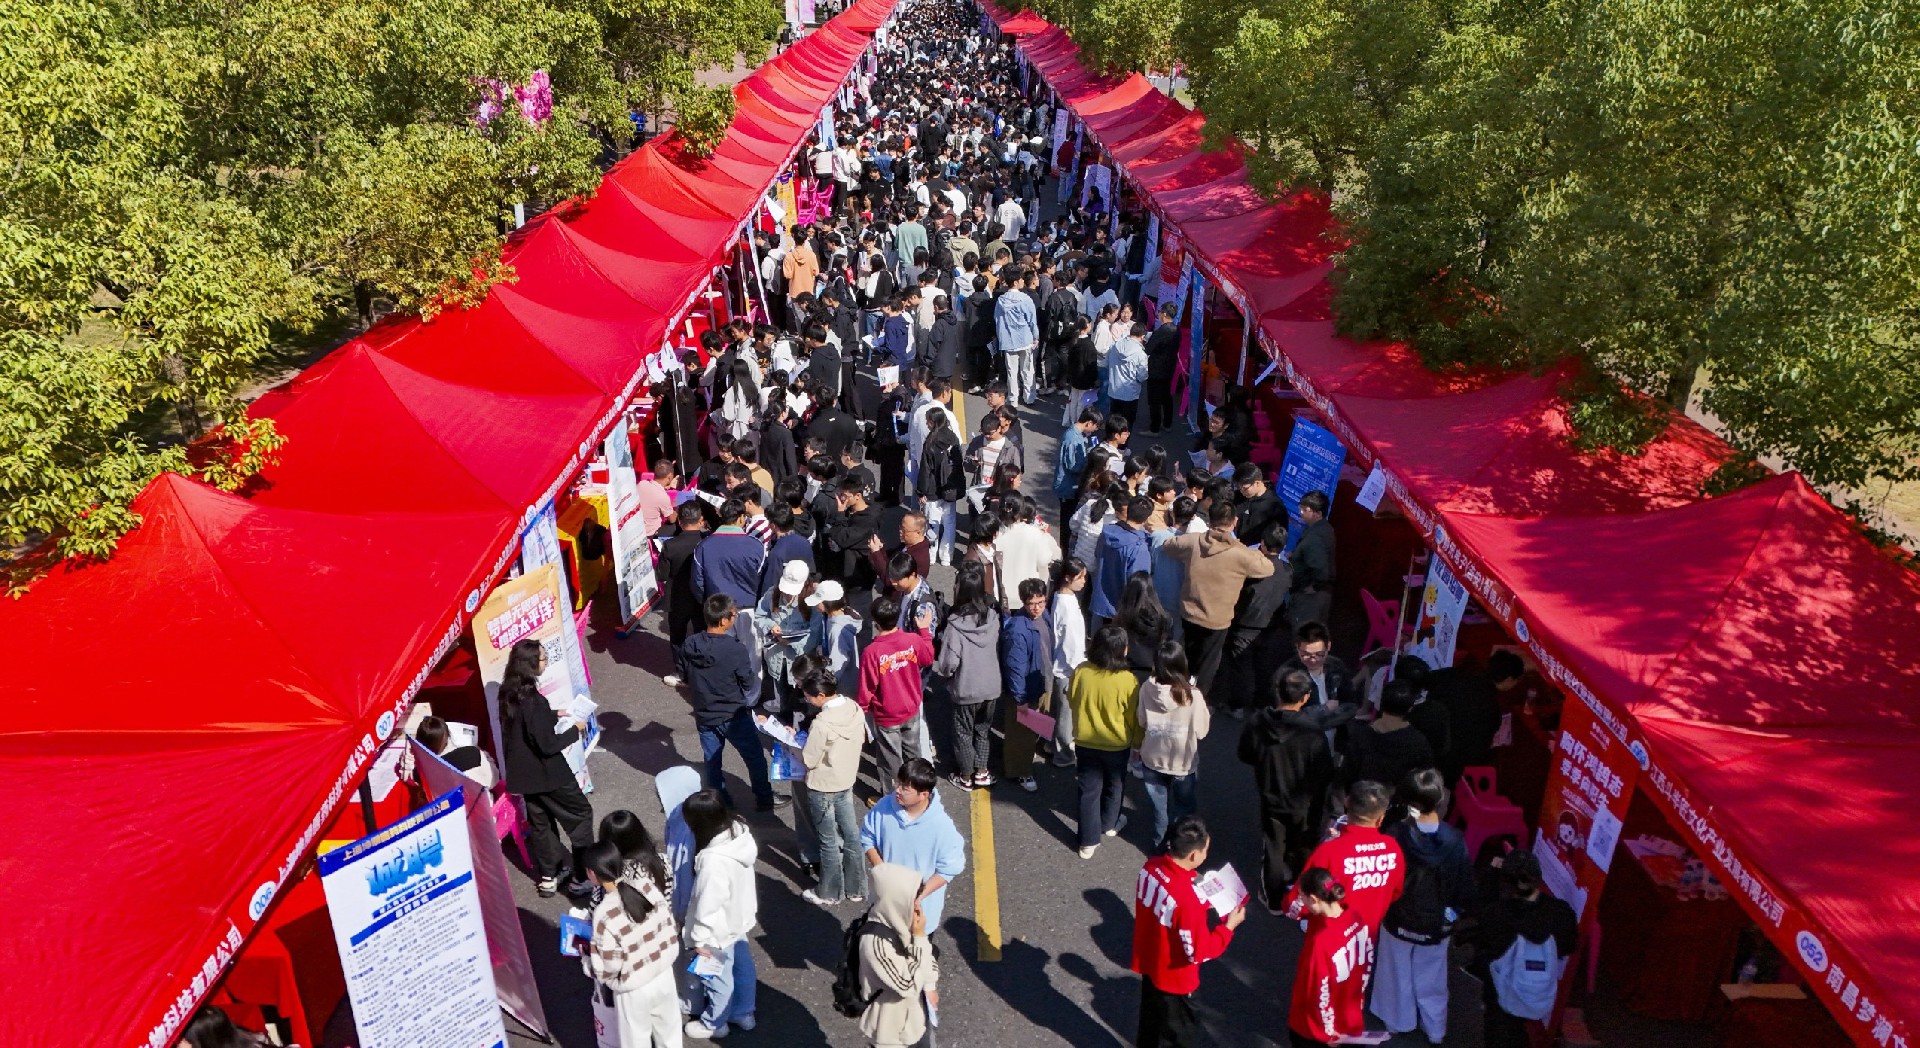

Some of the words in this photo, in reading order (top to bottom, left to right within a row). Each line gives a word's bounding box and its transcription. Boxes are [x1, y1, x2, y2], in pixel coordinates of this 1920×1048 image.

[1560, 730, 1624, 798] 胸怀鸿鹄志
[1343, 852, 1397, 875] SINCE
[1352, 871, 1390, 891] 2001
[253, 887, 272, 916] 006
[1800, 936, 1823, 967] 052
